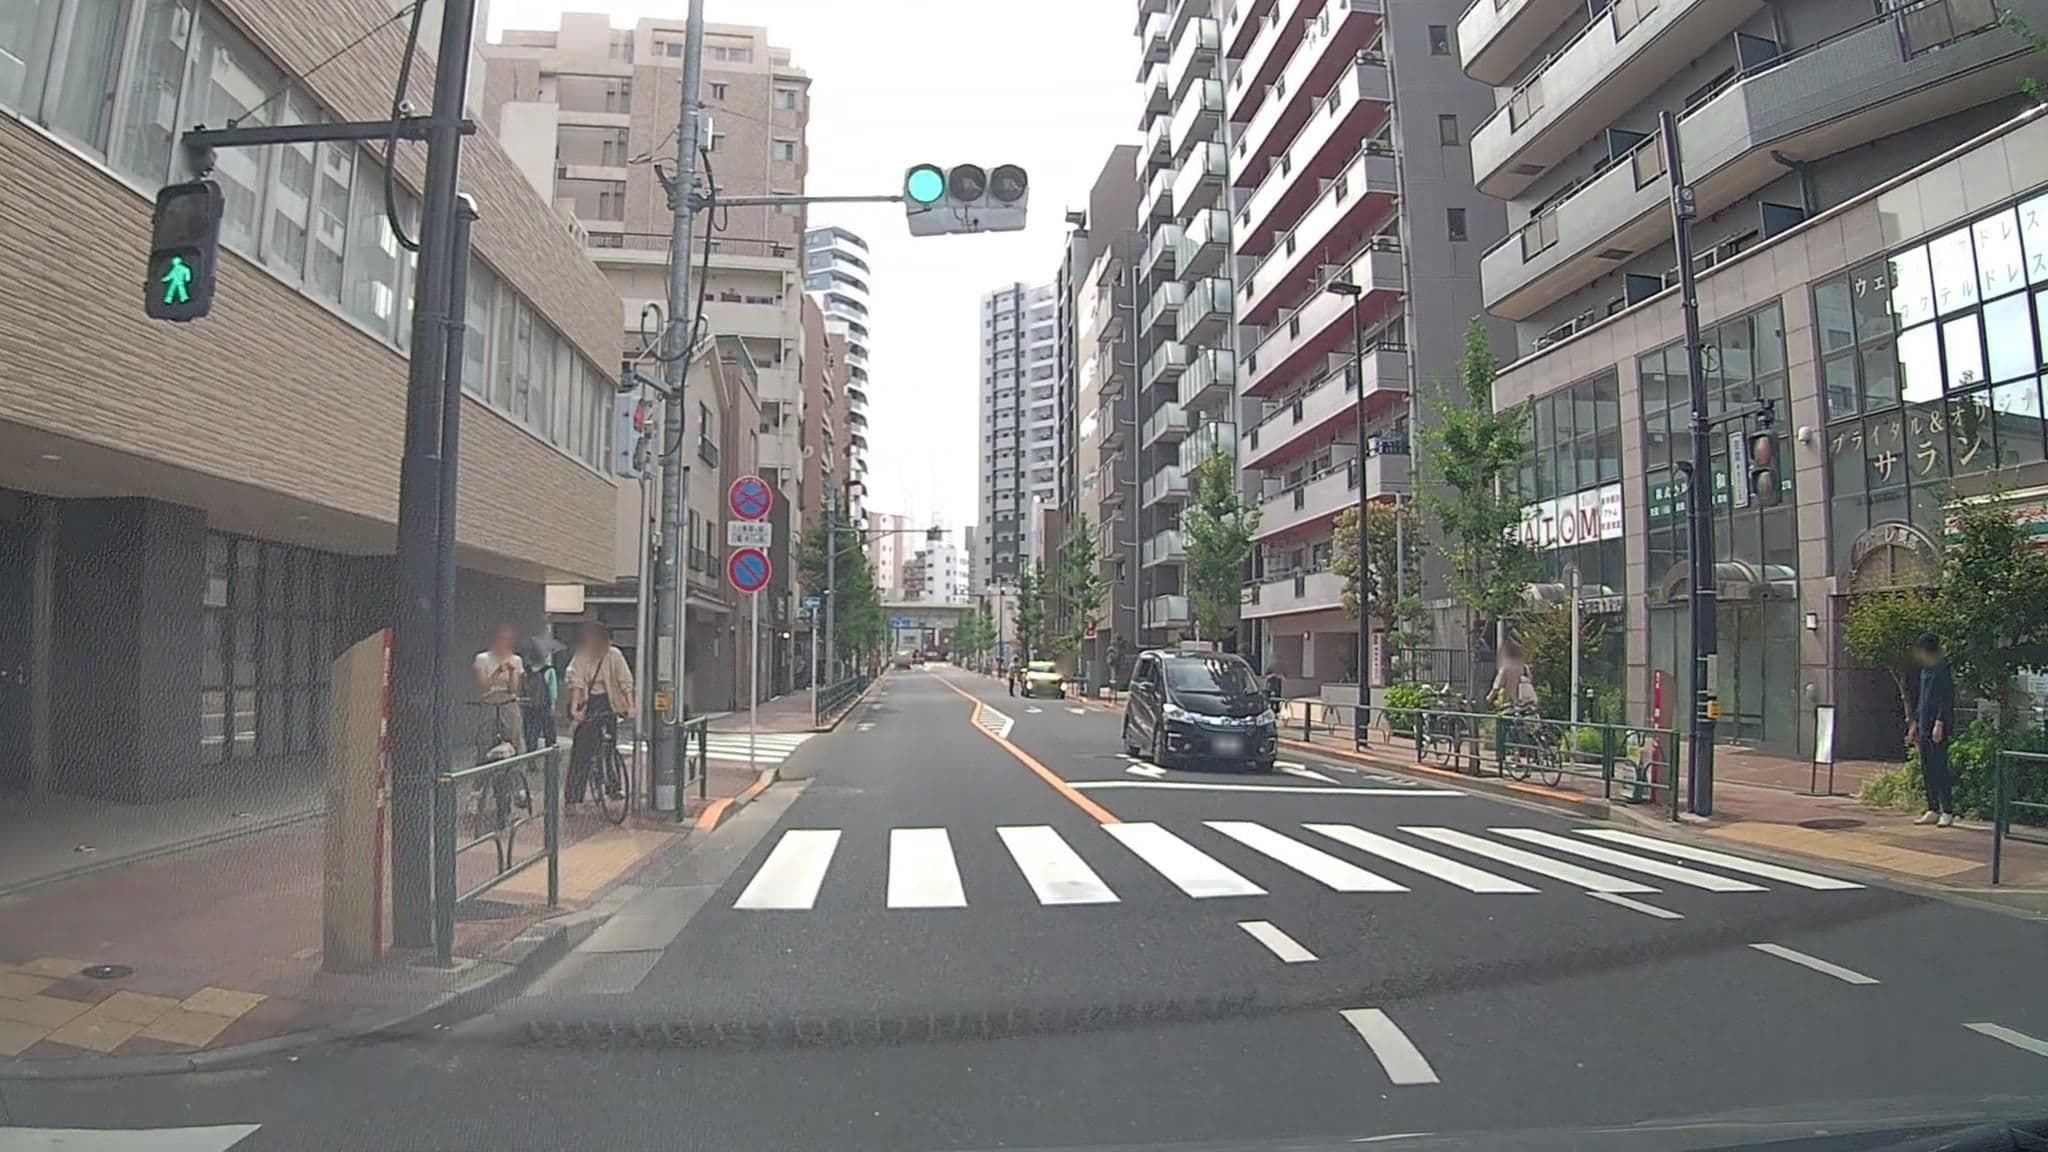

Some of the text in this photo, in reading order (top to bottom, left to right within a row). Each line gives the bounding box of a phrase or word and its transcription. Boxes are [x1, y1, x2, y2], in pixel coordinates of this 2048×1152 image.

[1873, 436, 1983, 482] サラン
[1524, 508, 1599, 544] ATOM
